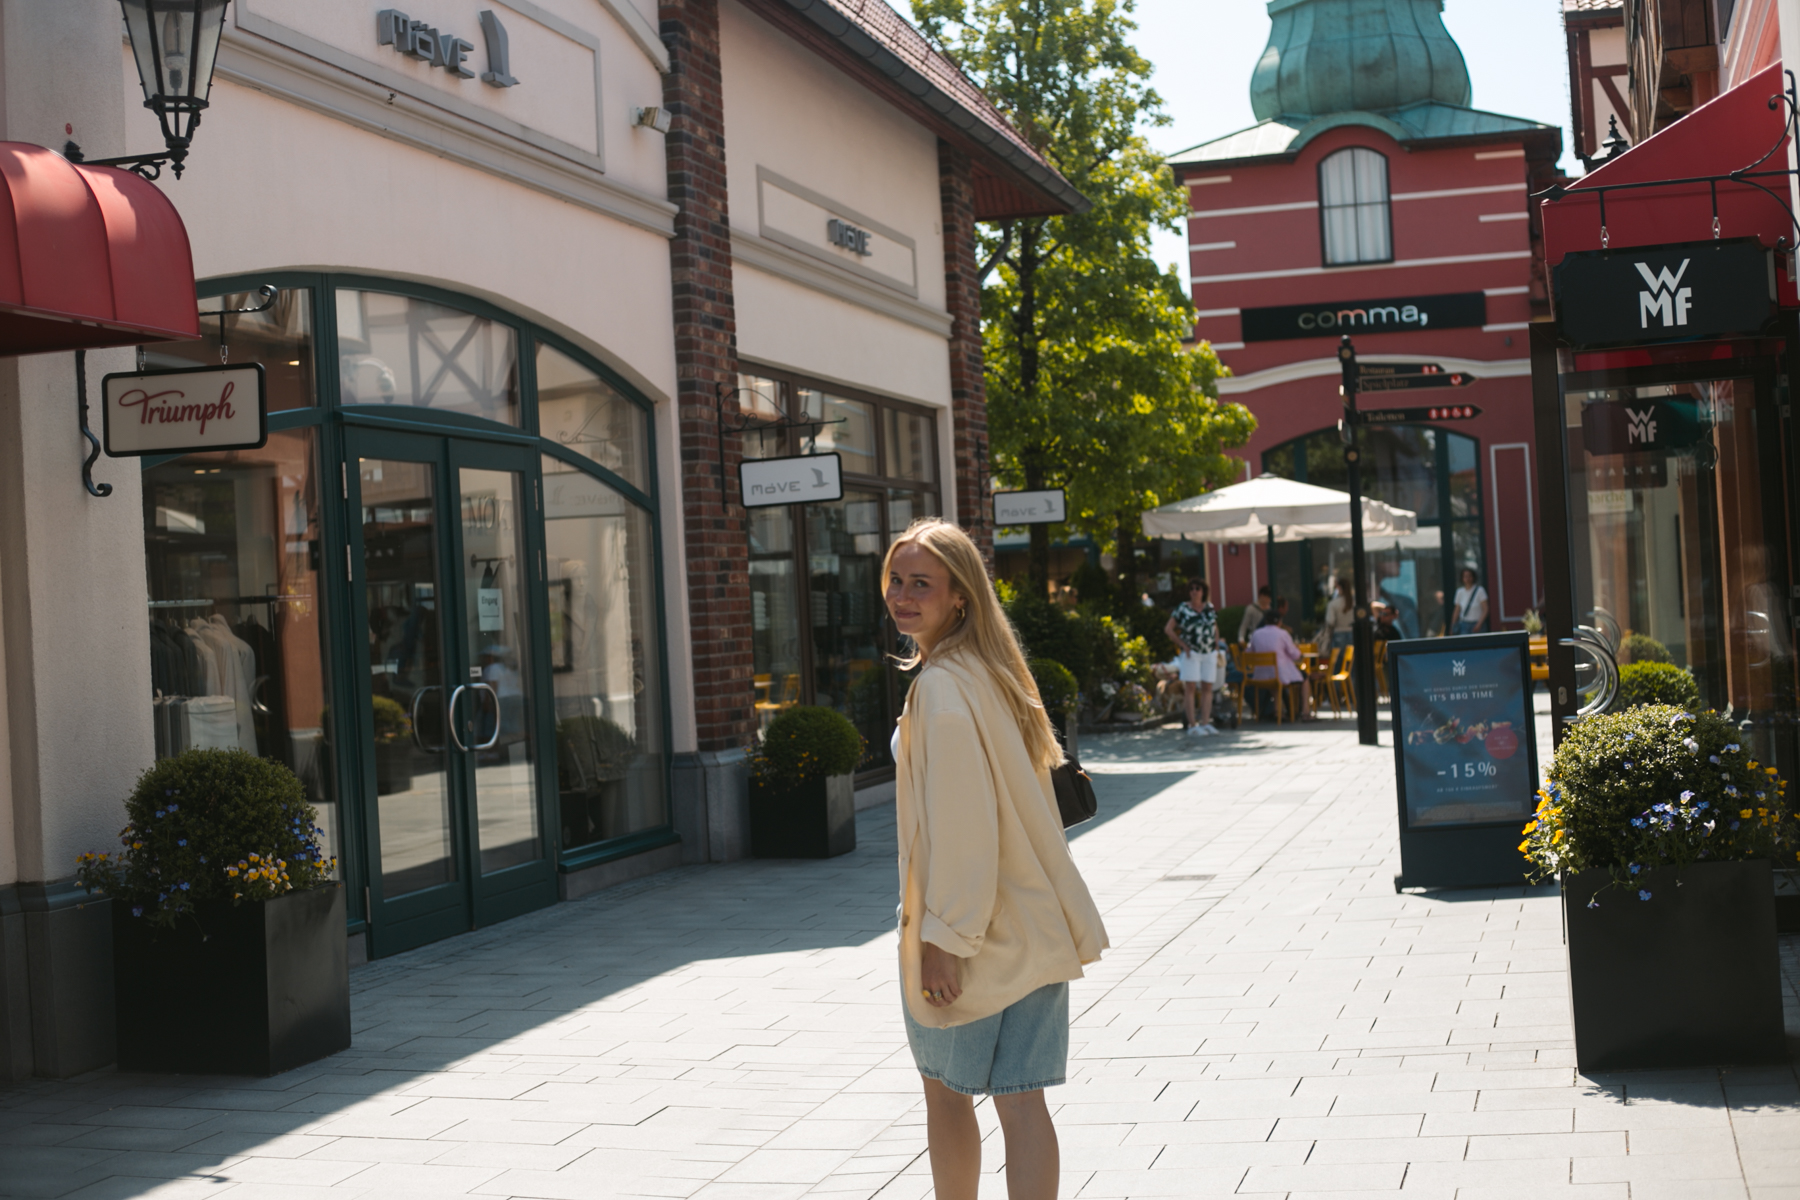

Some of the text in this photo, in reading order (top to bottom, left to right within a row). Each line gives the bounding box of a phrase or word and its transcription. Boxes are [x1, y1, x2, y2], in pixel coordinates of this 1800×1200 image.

[1634, 258, 1693, 328] WMF
[1297, 304, 1428, 330] comma,
[1362, 378, 1410, 391] Spielplatz
[119, 381, 236, 436] Triumph
[1625, 405, 1658, 444] WMF
[1594, 464, 1658, 478] FALKE
[1452, 659, 1467, 677] WMF
[1429, 690, 1494, 702] IT'S BBQ TIME
